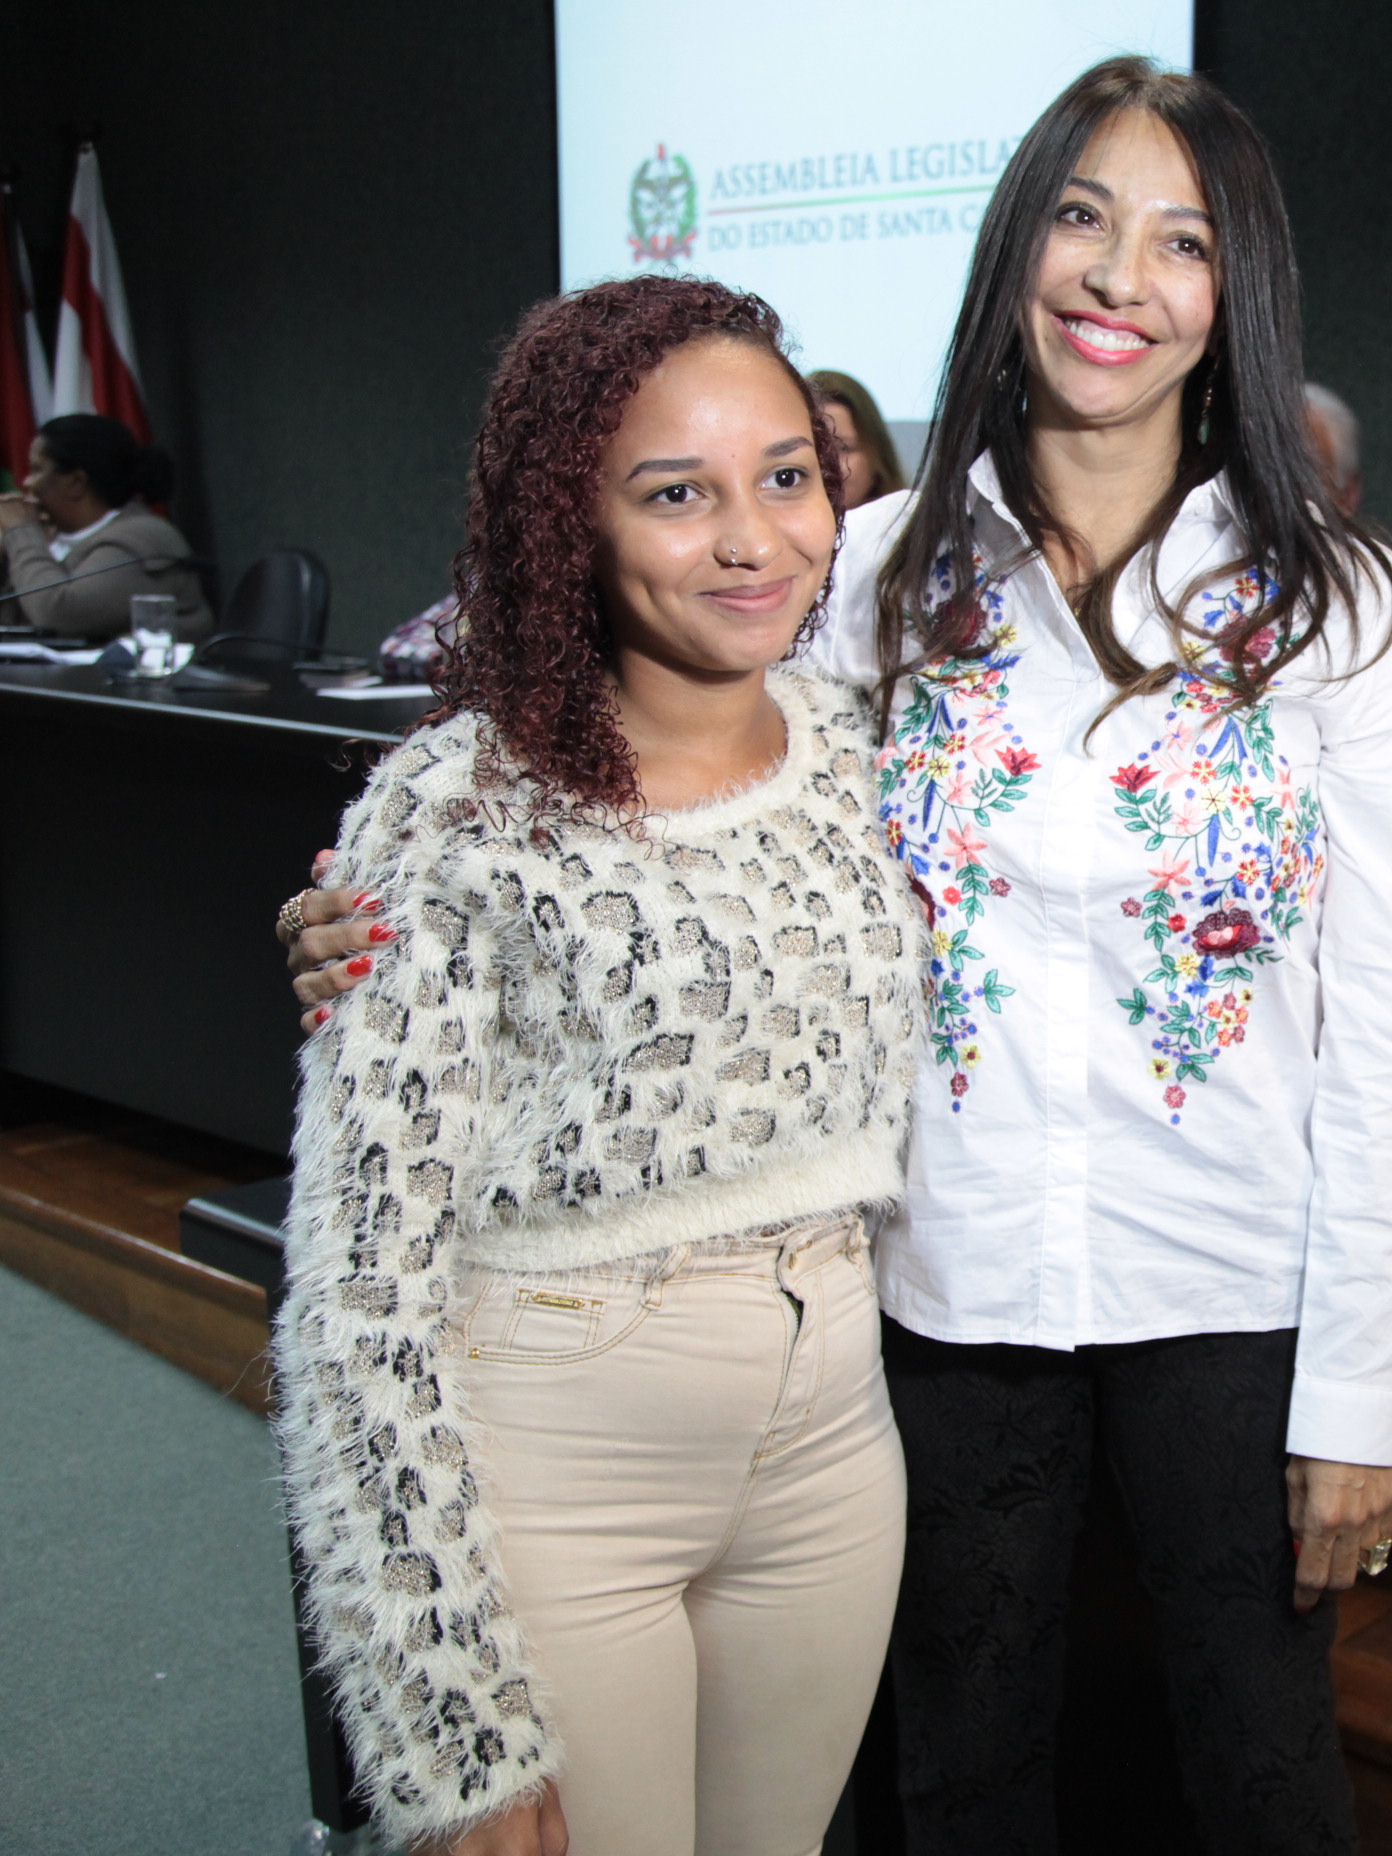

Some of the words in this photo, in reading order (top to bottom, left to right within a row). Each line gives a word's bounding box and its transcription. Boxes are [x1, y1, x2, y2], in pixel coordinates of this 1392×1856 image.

[711, 151, 878, 199] ASSEMBLEIA
[709, 223, 742, 251] DO
[748, 215, 834, 249] ESTADO
[841, 212, 870, 241] DE
[878, 208, 952, 238] SANTA
